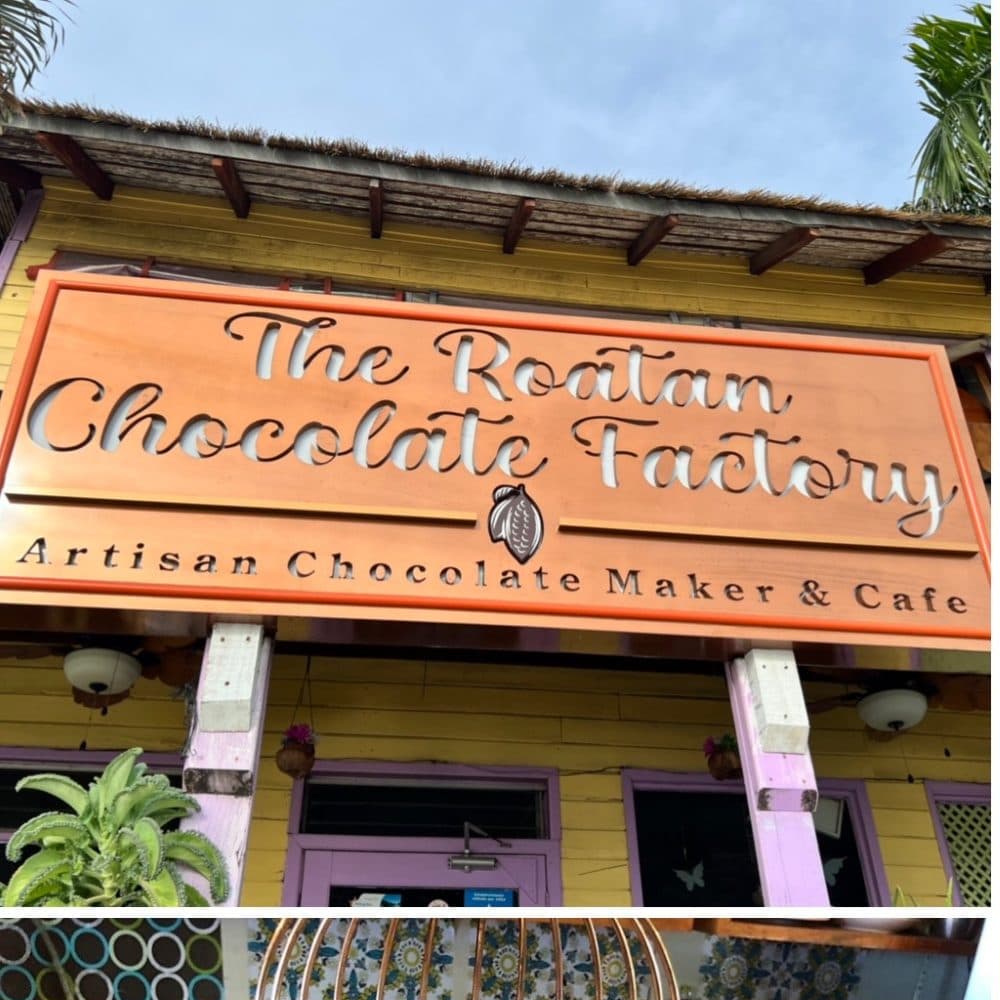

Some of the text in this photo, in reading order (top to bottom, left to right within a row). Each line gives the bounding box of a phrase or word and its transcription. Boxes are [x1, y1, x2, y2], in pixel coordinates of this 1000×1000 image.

[223, 311, 793, 414] The Roatan
[26, 376, 958, 538] Chocolate Factory
[16, 537, 968, 615] Artisan Chocolate Maker & Cafe
